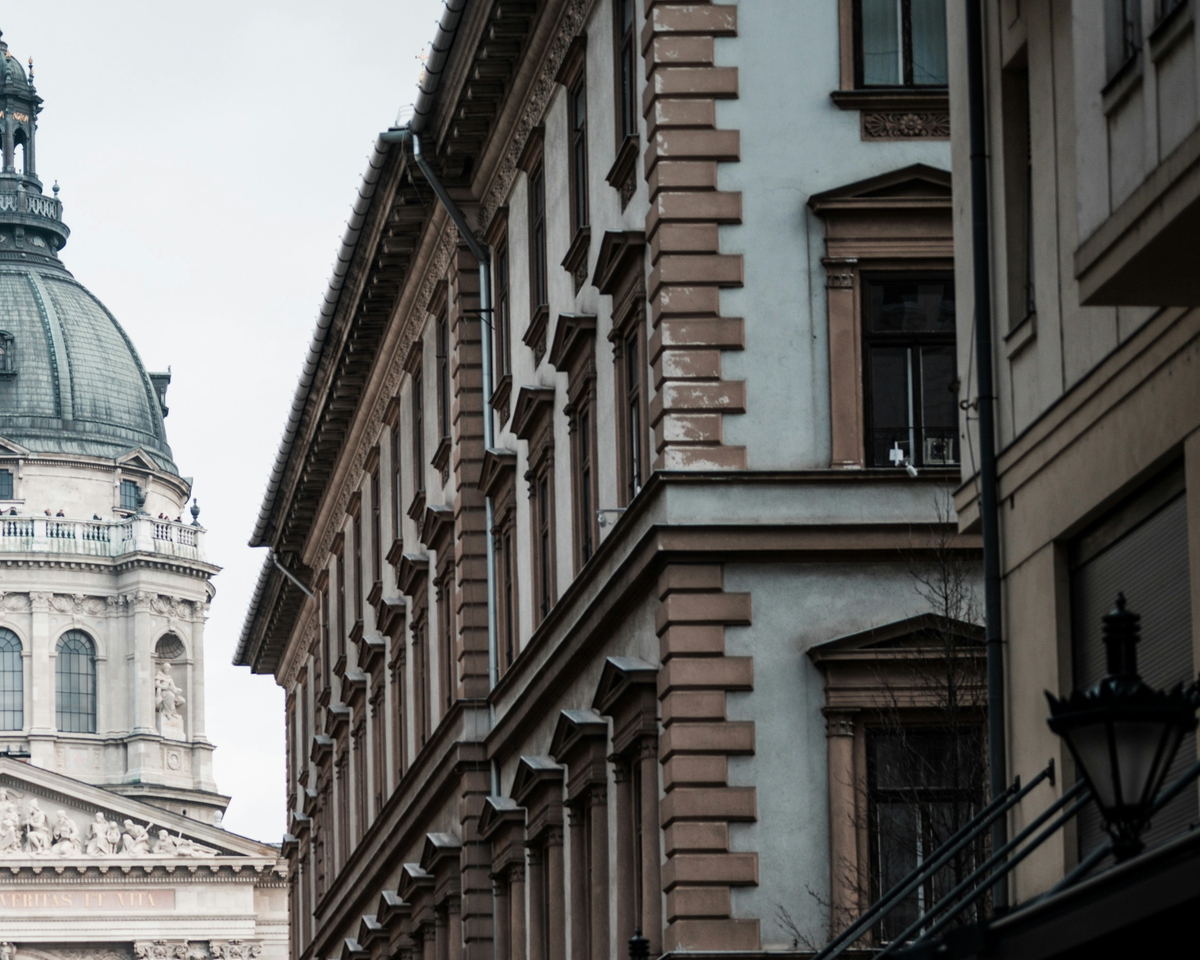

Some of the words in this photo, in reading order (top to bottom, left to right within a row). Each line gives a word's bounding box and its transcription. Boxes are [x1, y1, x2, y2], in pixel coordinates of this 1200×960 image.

[0, 893, 73, 908] VERITAS
[84, 893, 106, 907] ET
[117, 892, 156, 907] VITA
